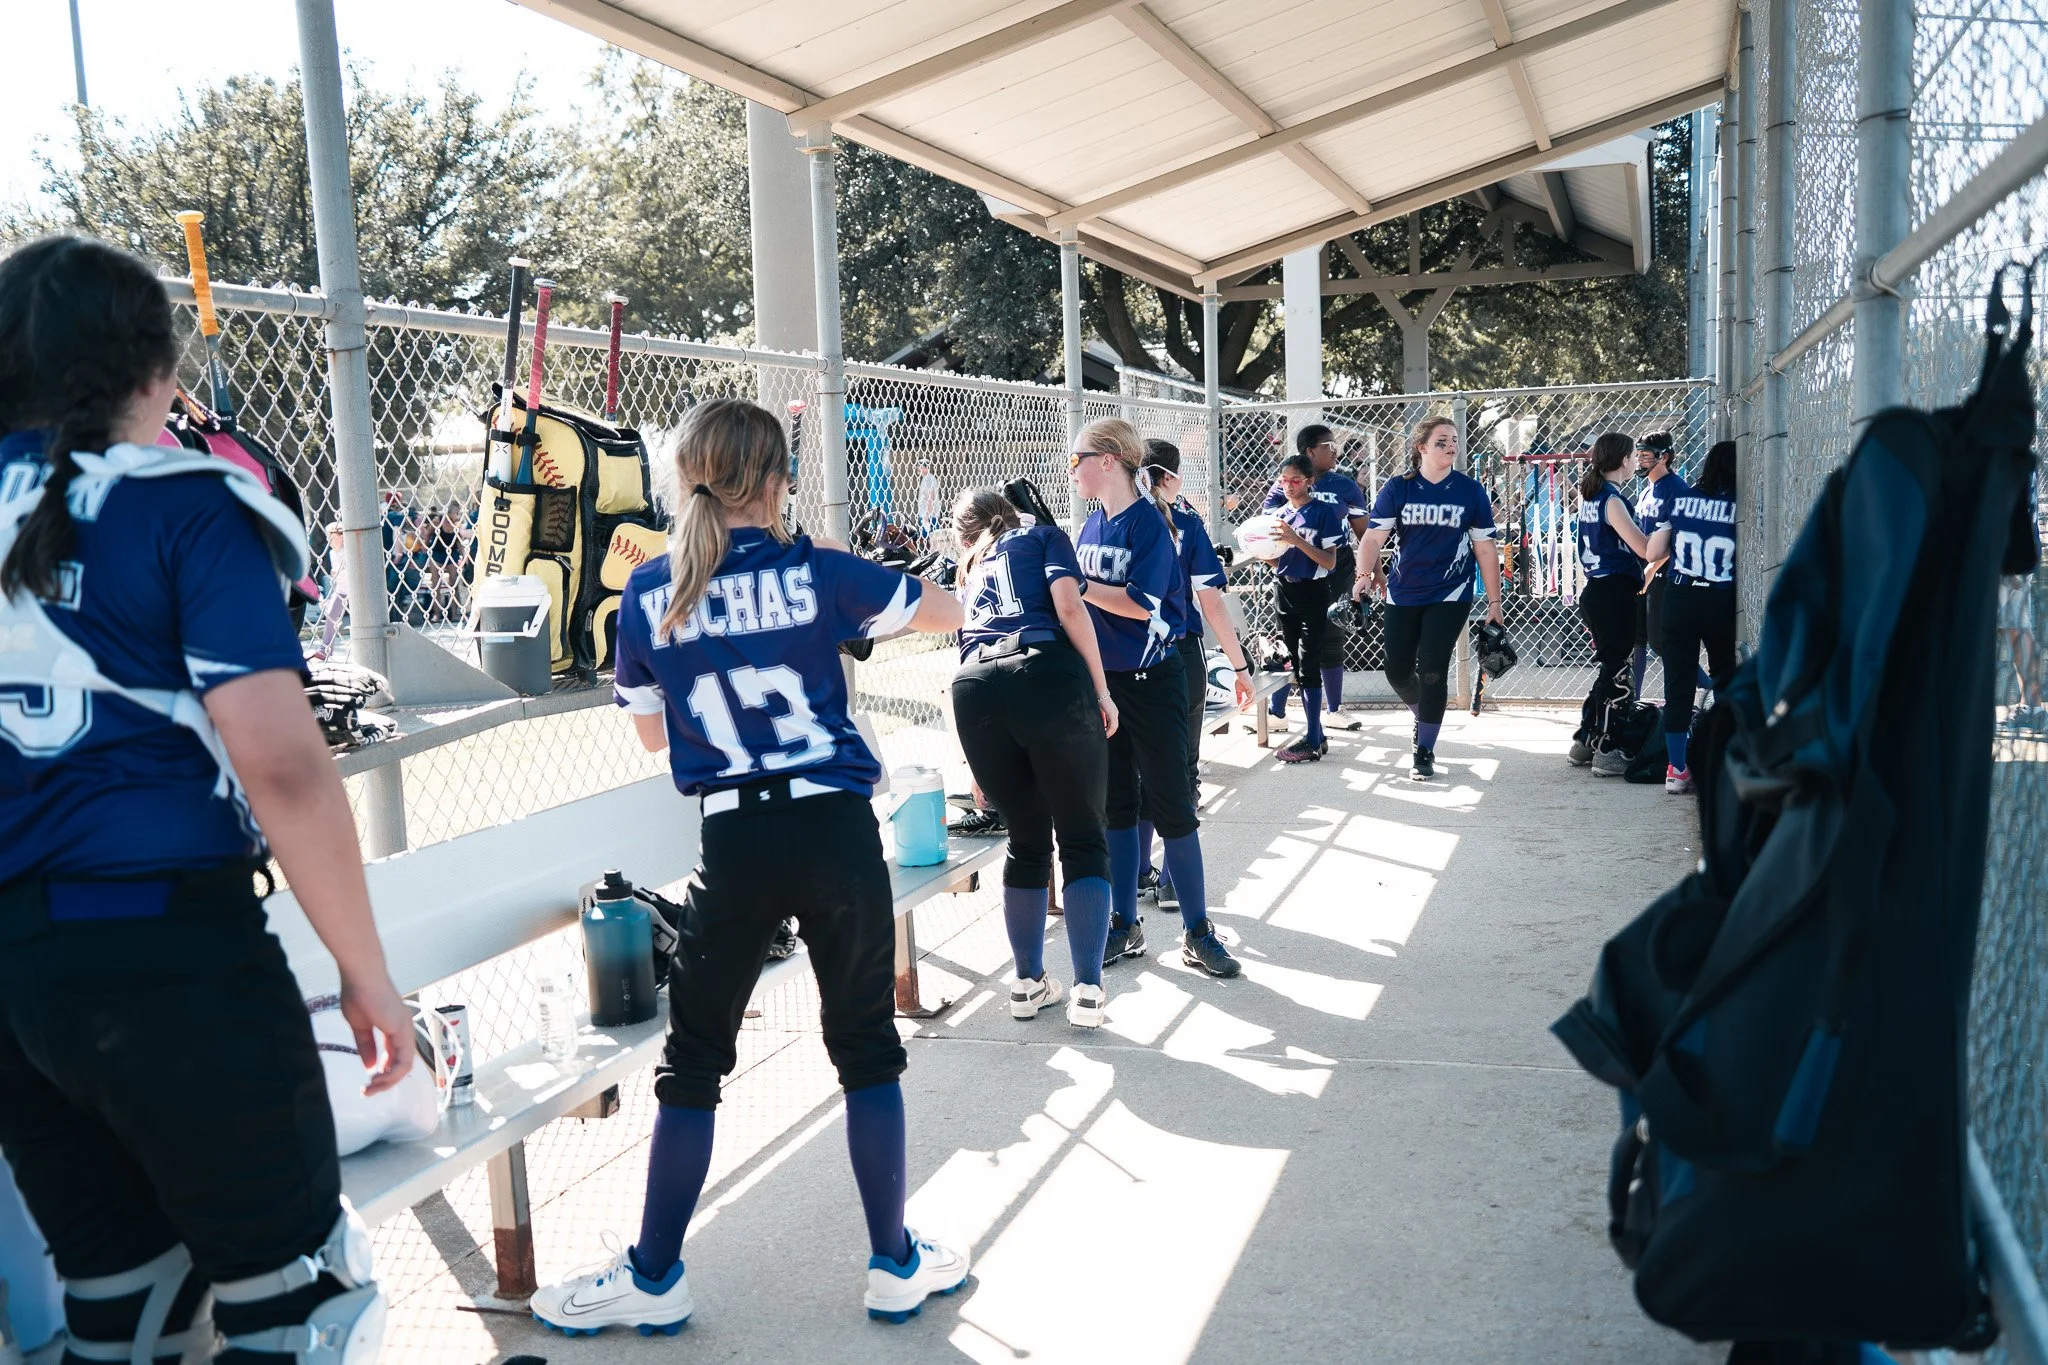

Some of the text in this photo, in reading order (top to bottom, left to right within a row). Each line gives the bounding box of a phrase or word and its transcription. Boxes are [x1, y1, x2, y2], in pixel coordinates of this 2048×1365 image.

[1401, 502, 1466, 529] SHOCK
[1674, 530, 1736, 582] 00
[687, 663, 837, 778] 13
